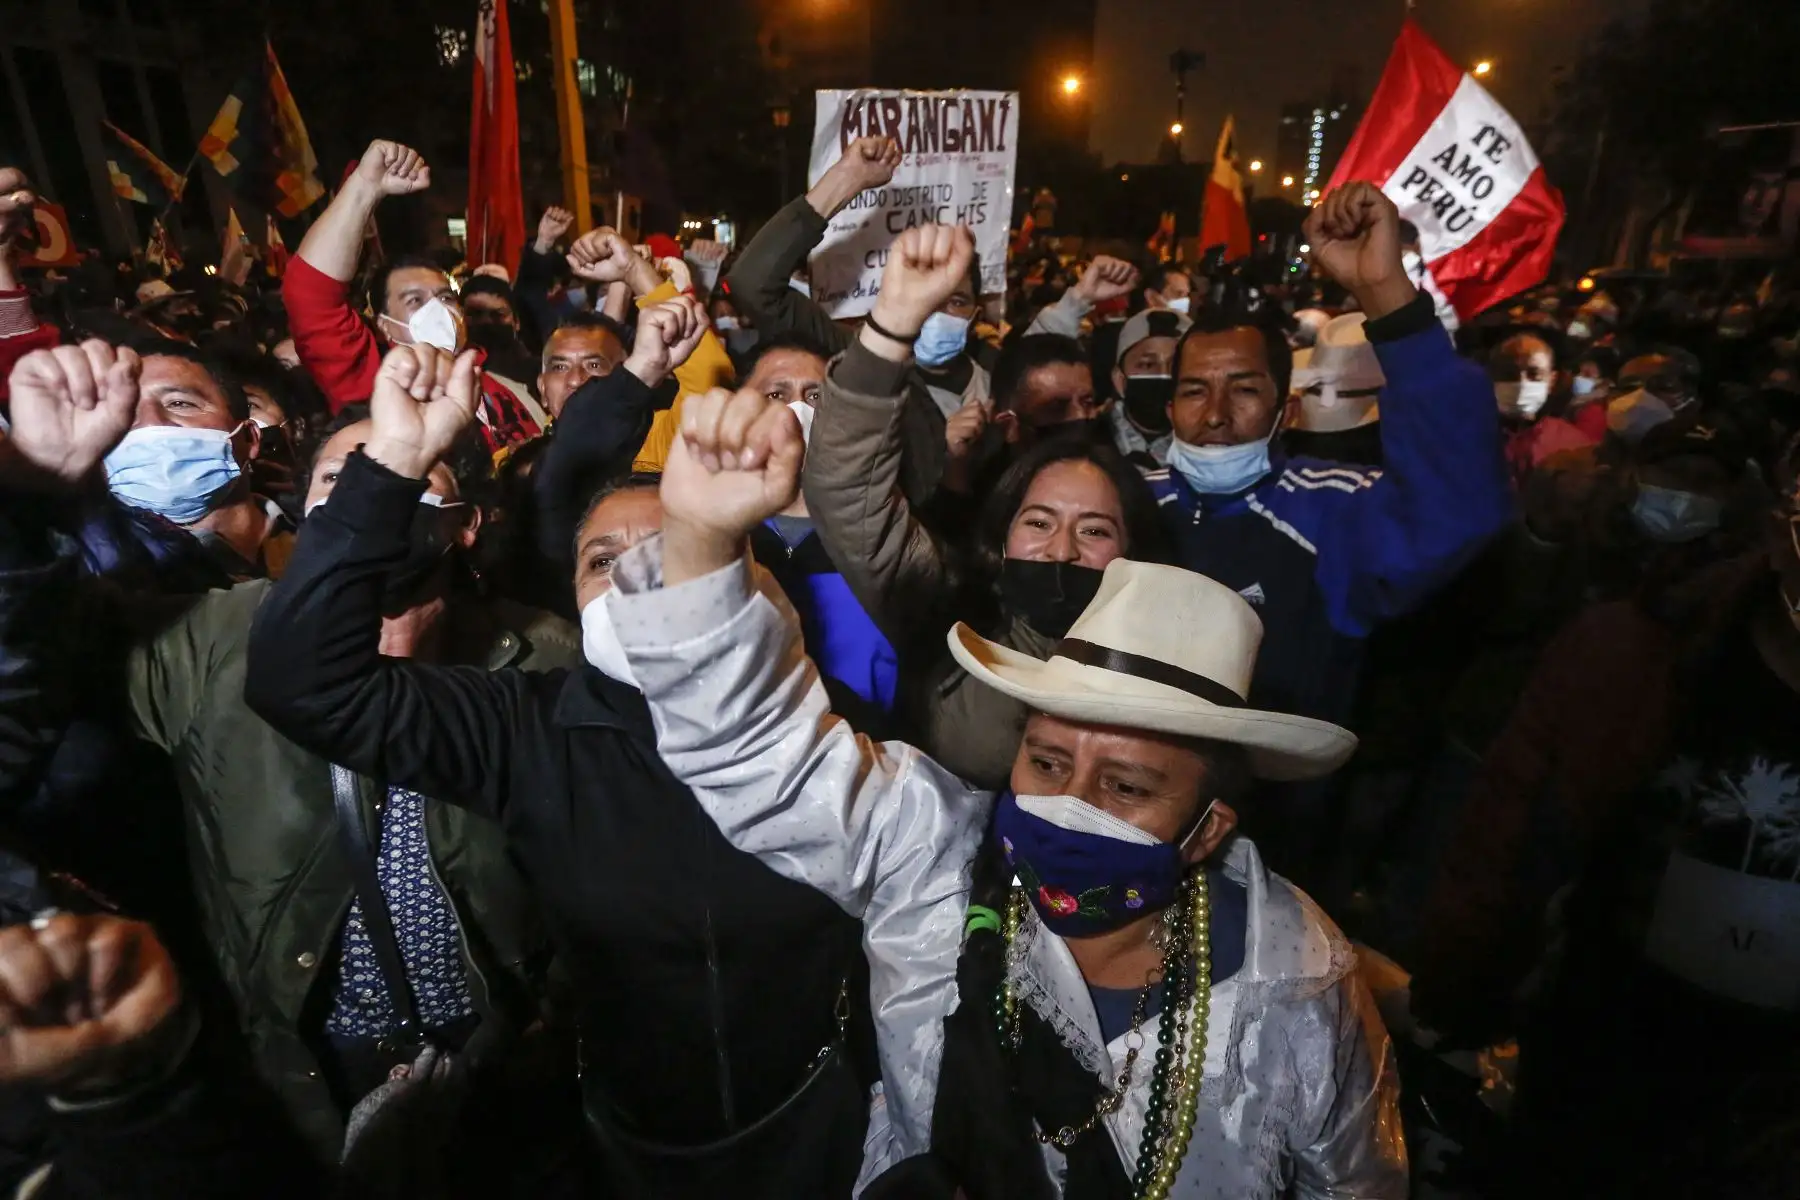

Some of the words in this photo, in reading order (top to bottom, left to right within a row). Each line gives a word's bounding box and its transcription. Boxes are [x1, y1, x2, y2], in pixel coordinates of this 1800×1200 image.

[1472, 125, 1512, 165] TE
[848, 189, 887, 209] UNDO
[891, 184, 953, 207] DISTRITO
[970, 181, 989, 201] DE
[1432, 143, 1494, 200] AMO
[1400, 166, 1477, 233] PERÚ
